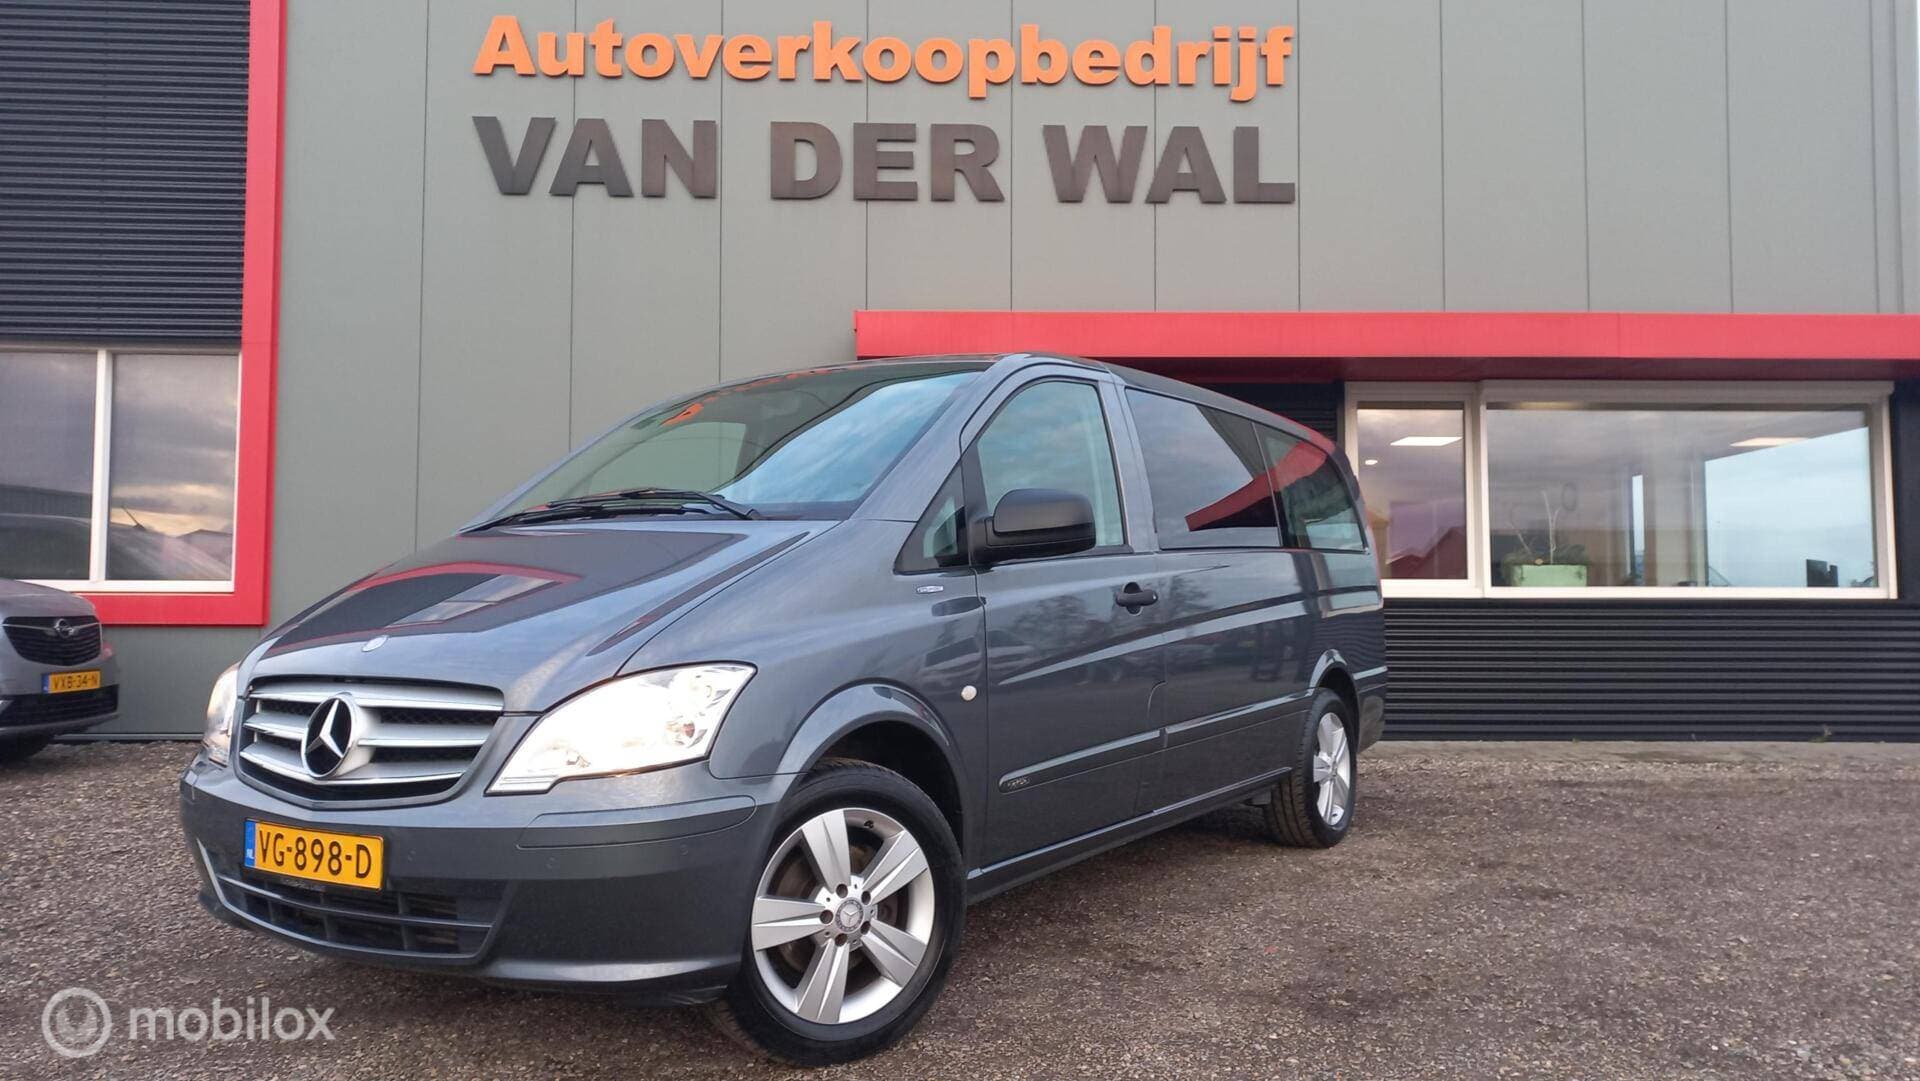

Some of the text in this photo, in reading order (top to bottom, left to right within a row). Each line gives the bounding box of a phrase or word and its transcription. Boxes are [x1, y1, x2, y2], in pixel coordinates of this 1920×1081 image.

[472, 15, 1294, 102] Autoverkoopbedrijf
[472, 116, 1296, 204] VAN DER WAL
[259, 829, 372, 879] VG-898-D
